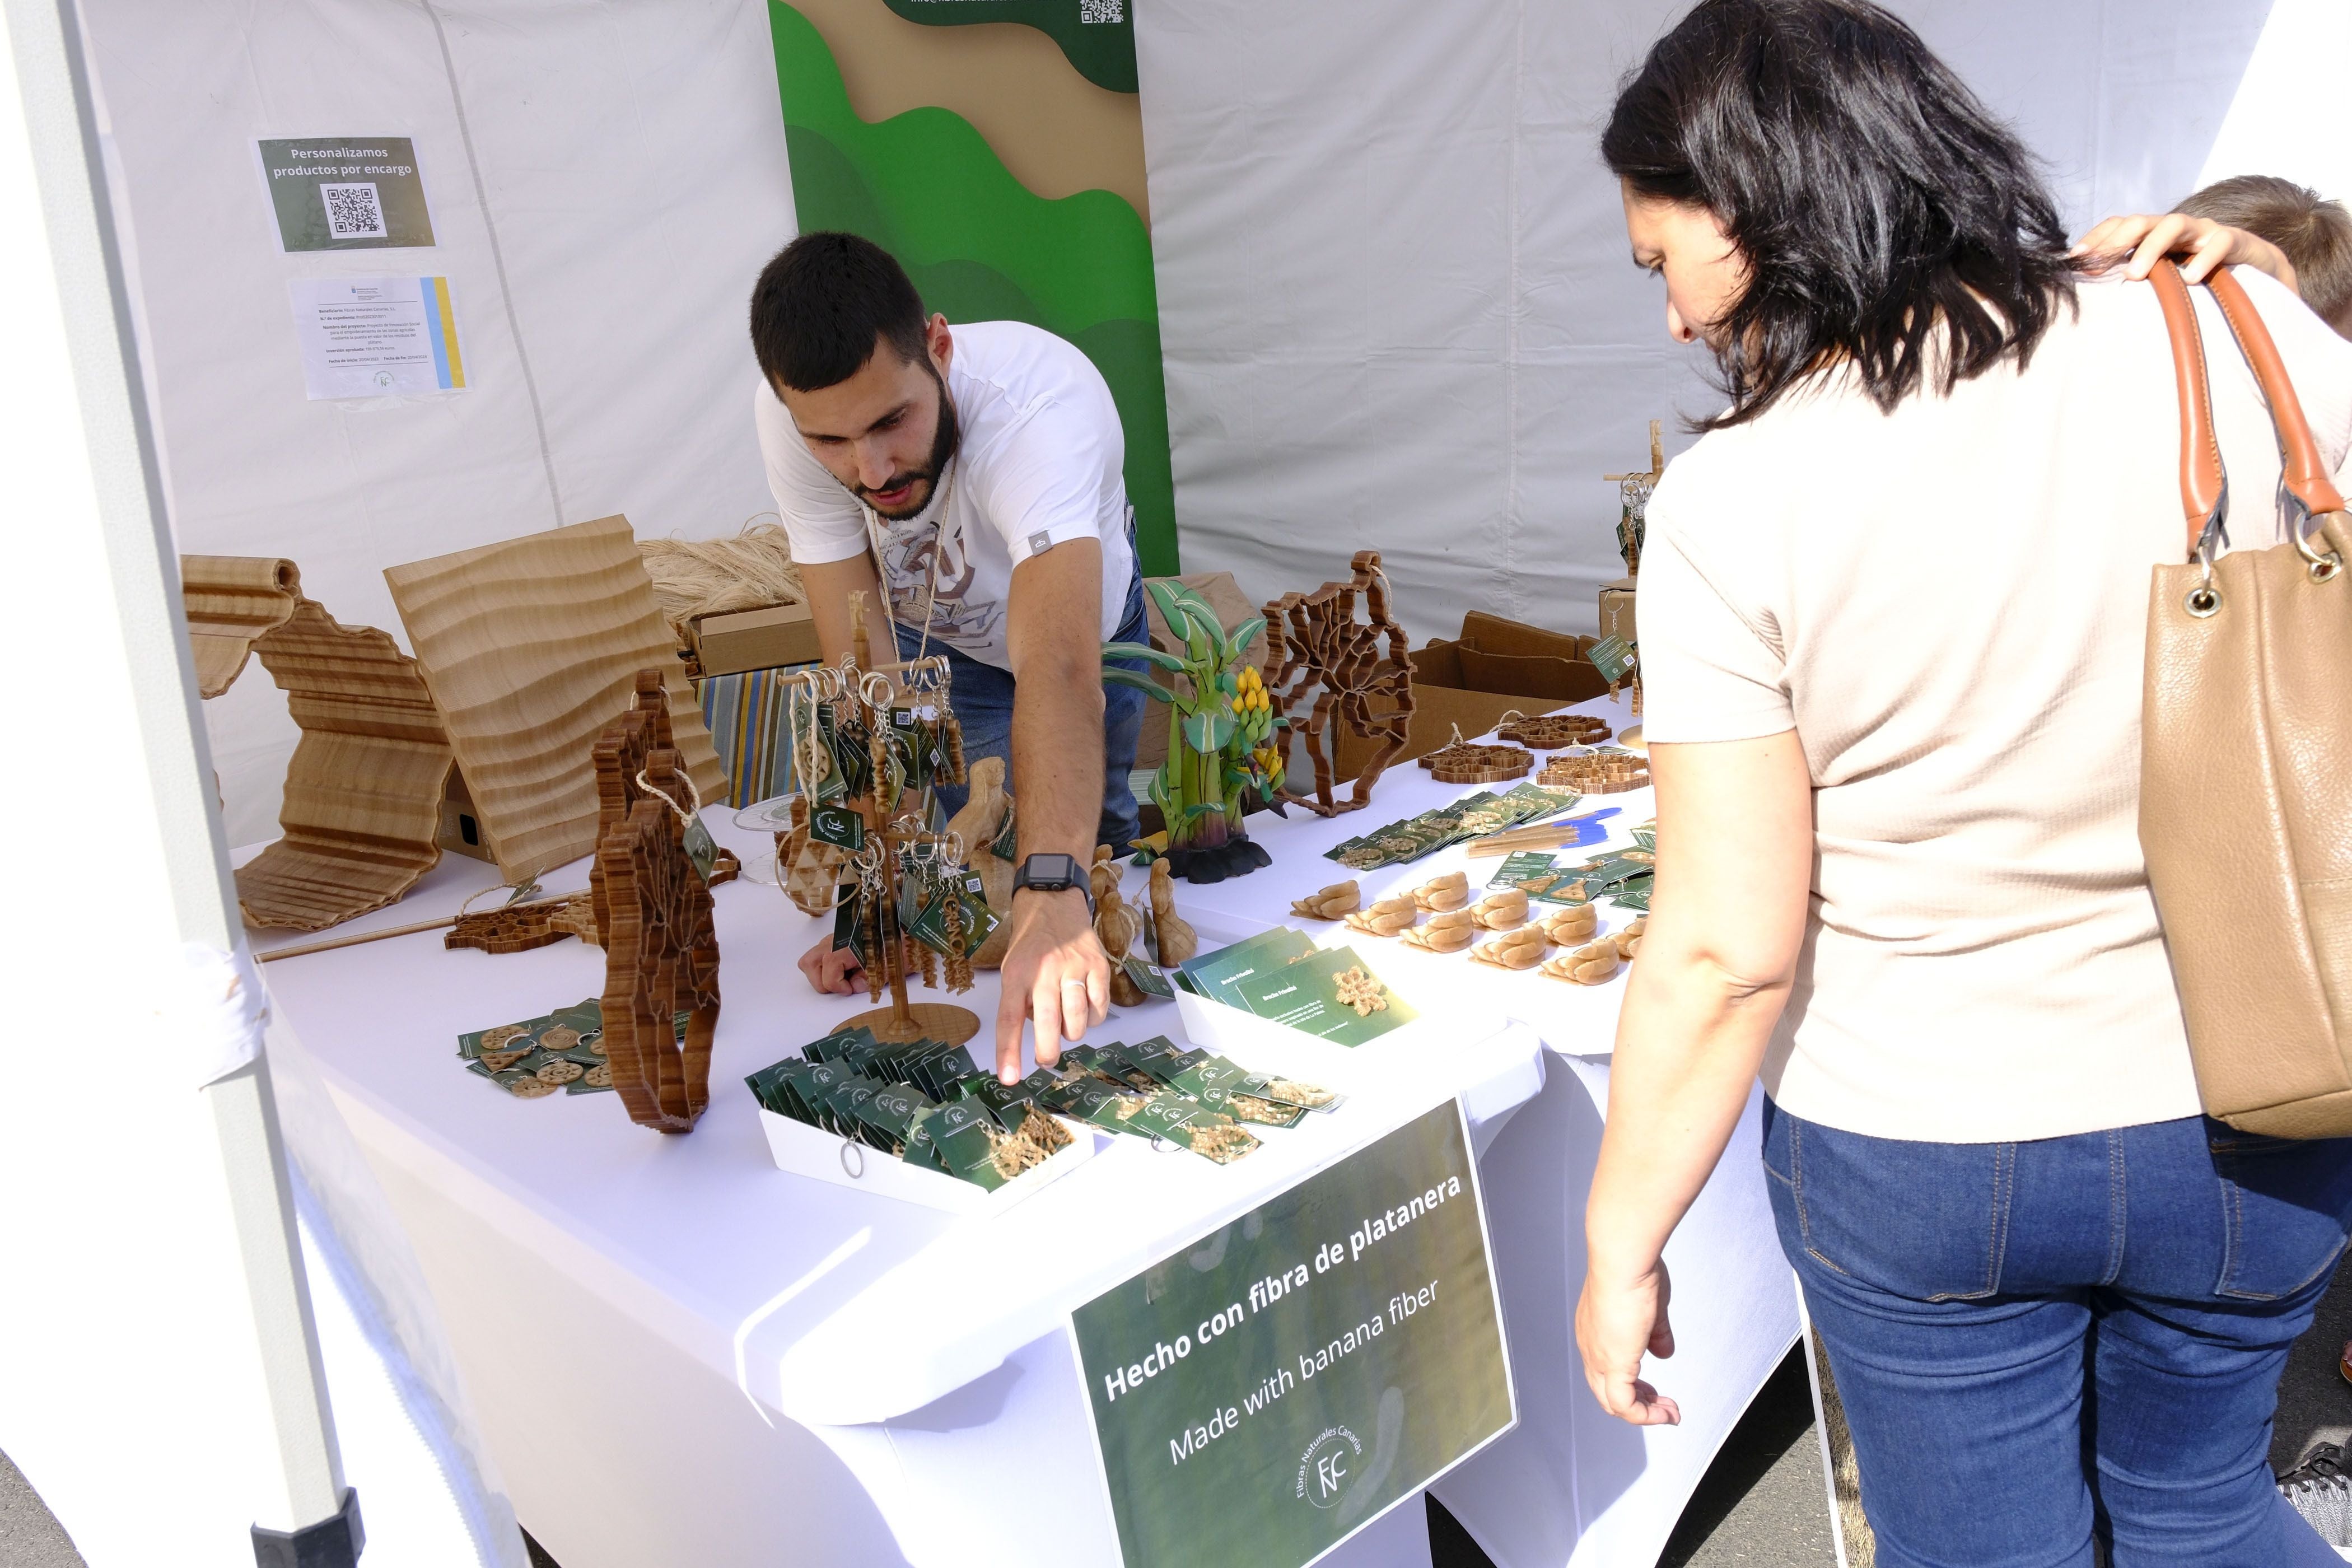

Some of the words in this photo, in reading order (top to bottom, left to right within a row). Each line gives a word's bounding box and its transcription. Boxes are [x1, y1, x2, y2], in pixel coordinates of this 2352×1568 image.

[273, 166, 337, 179] productos
[340, 165, 361, 176] por
[365, 164, 412, 176] encargo
[291, 147, 388, 159] Personalizamos
[1104, 1336, 1191, 1402] Hecho
[1198, 1303, 1244, 1344] con
[1249, 1264, 1309, 1313] fibra
[1315, 1243, 1344, 1273] de
[1350, 1174, 1461, 1262] platanera
[1170, 1408, 1239, 1466] Made
[1243, 1368, 1294, 1416] with
[1299, 1315, 1384, 1380] banana
[1388, 1278, 1439, 1325] fiber
[1296, 1465, 1306, 1499] Fibras
[1301, 1427, 1337, 1463] Naturales
[1338, 1425, 1362, 1455] Canarias
